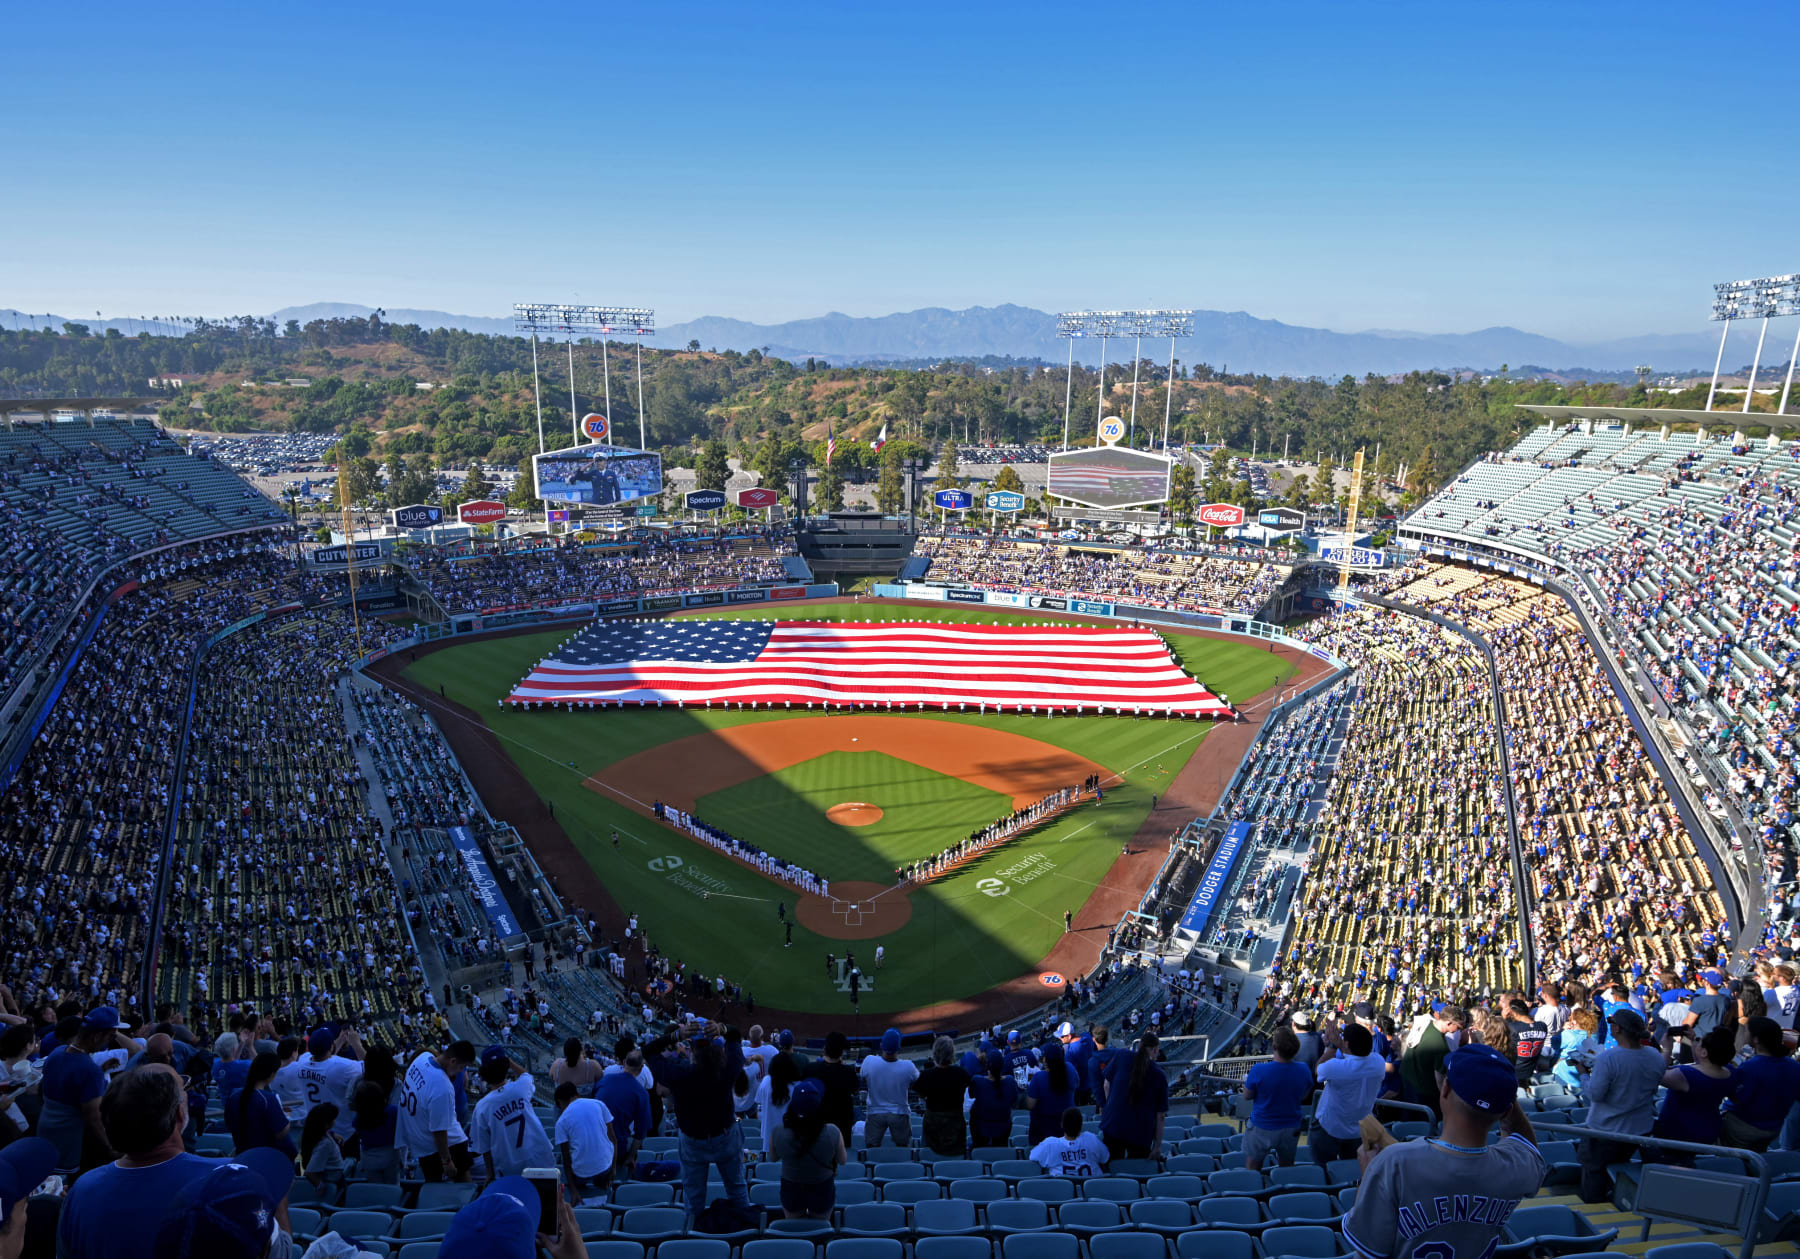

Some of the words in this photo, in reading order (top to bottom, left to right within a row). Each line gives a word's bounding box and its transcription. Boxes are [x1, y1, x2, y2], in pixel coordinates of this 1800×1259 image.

[589, 421, 604, 433] 76
[1105, 424, 1119, 435] 76
[690, 496, 720, 505] Spectrum
[1000, 495, 1020, 504] Security
[399, 511, 426, 521] blue
[1260, 514, 1276, 523] UCLA
[1279, 516, 1300, 525] Health
[318, 547, 376, 562] CUTWATER
[995, 852, 1047, 878] Security
[1011, 861, 1057, 885] Benefit
[1195, 871, 1222, 906] DODGER
[1214, 836, 1240, 869] STADIUM
[465, 859, 487, 884] Angeles
[476, 879, 498, 908] Dodgers
[682, 865, 731, 893] Security
[497, 914, 512, 935] Spectrum
[1043, 975, 1061, 984] 76
[1517, 1041, 1544, 1057] 22
[1012, 1055, 1028, 1066] BETTS
[408, 1064, 426, 1091] BETTS
[306, 1083, 321, 1103] 2
[399, 1080, 418, 1116] 50
[504, 1113, 526, 1148] 7
[1061, 1149, 1087, 1161] BETTS
